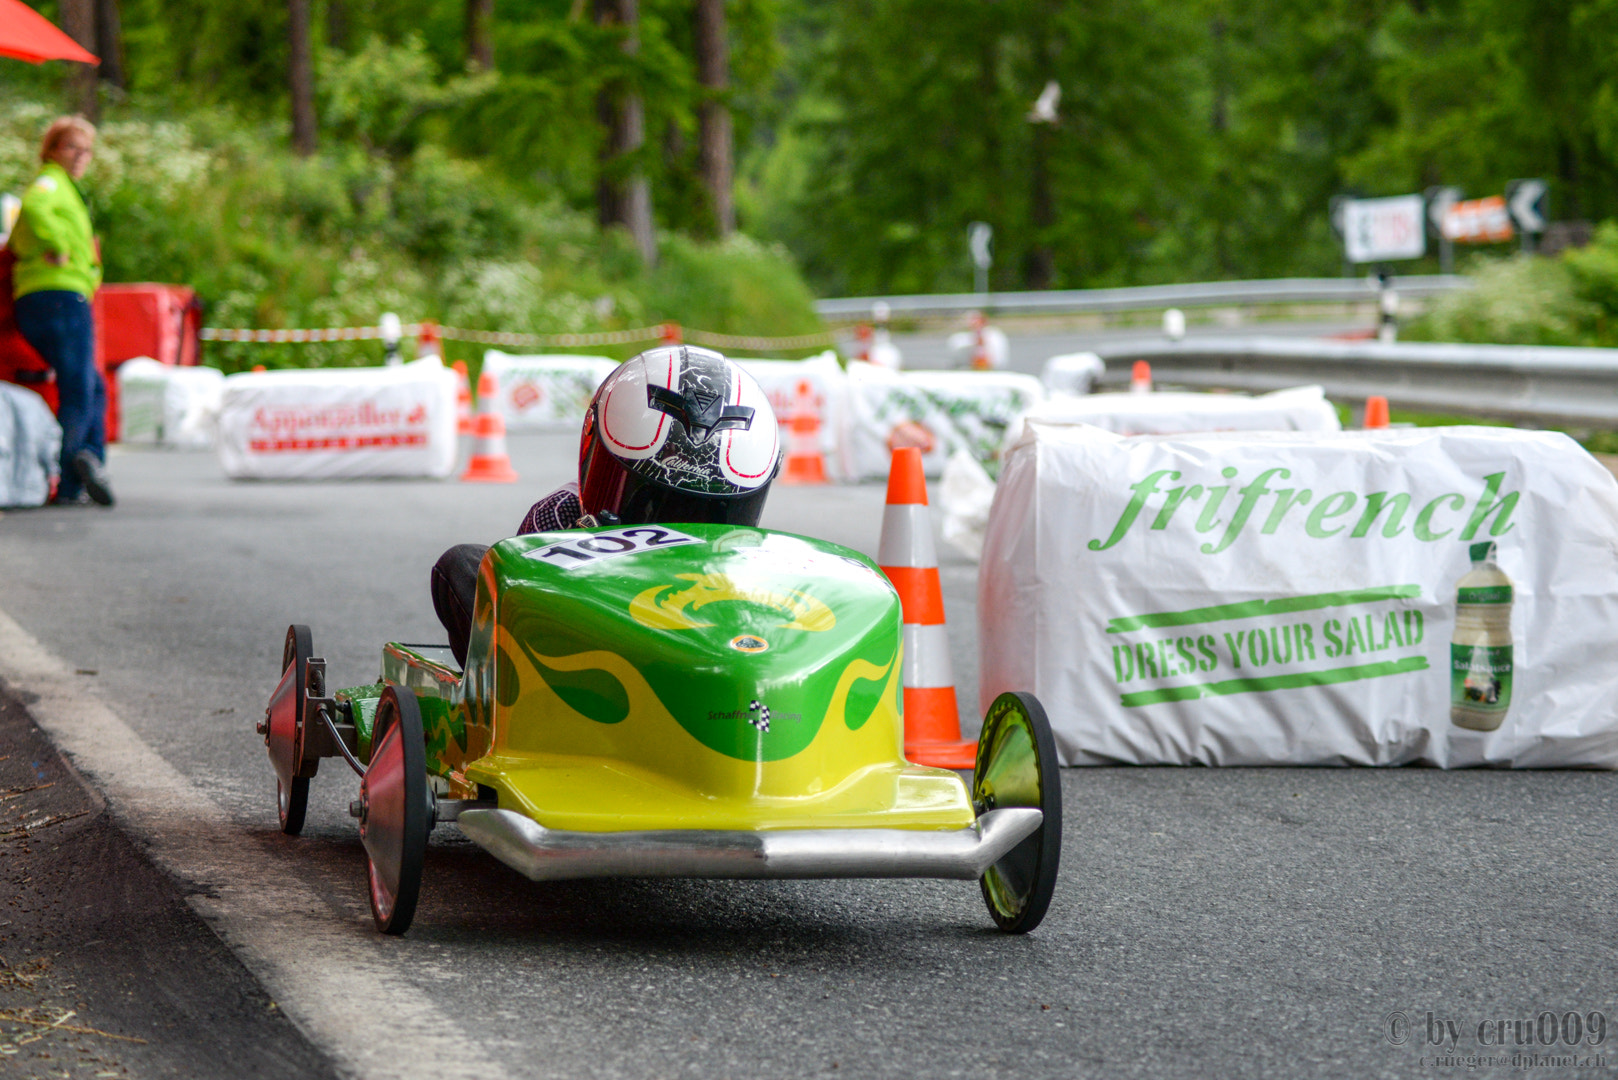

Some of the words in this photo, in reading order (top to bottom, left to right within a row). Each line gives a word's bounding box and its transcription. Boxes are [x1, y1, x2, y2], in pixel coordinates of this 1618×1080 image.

[661, 456, 713, 475] California
[1087, 466, 1520, 554] frifrench
[541, 529, 690, 561] 102
[1112, 635, 1217, 684] DRESS
[1224, 622, 1316, 669] YOUR
[1323, 609, 1425, 659] SALAD
